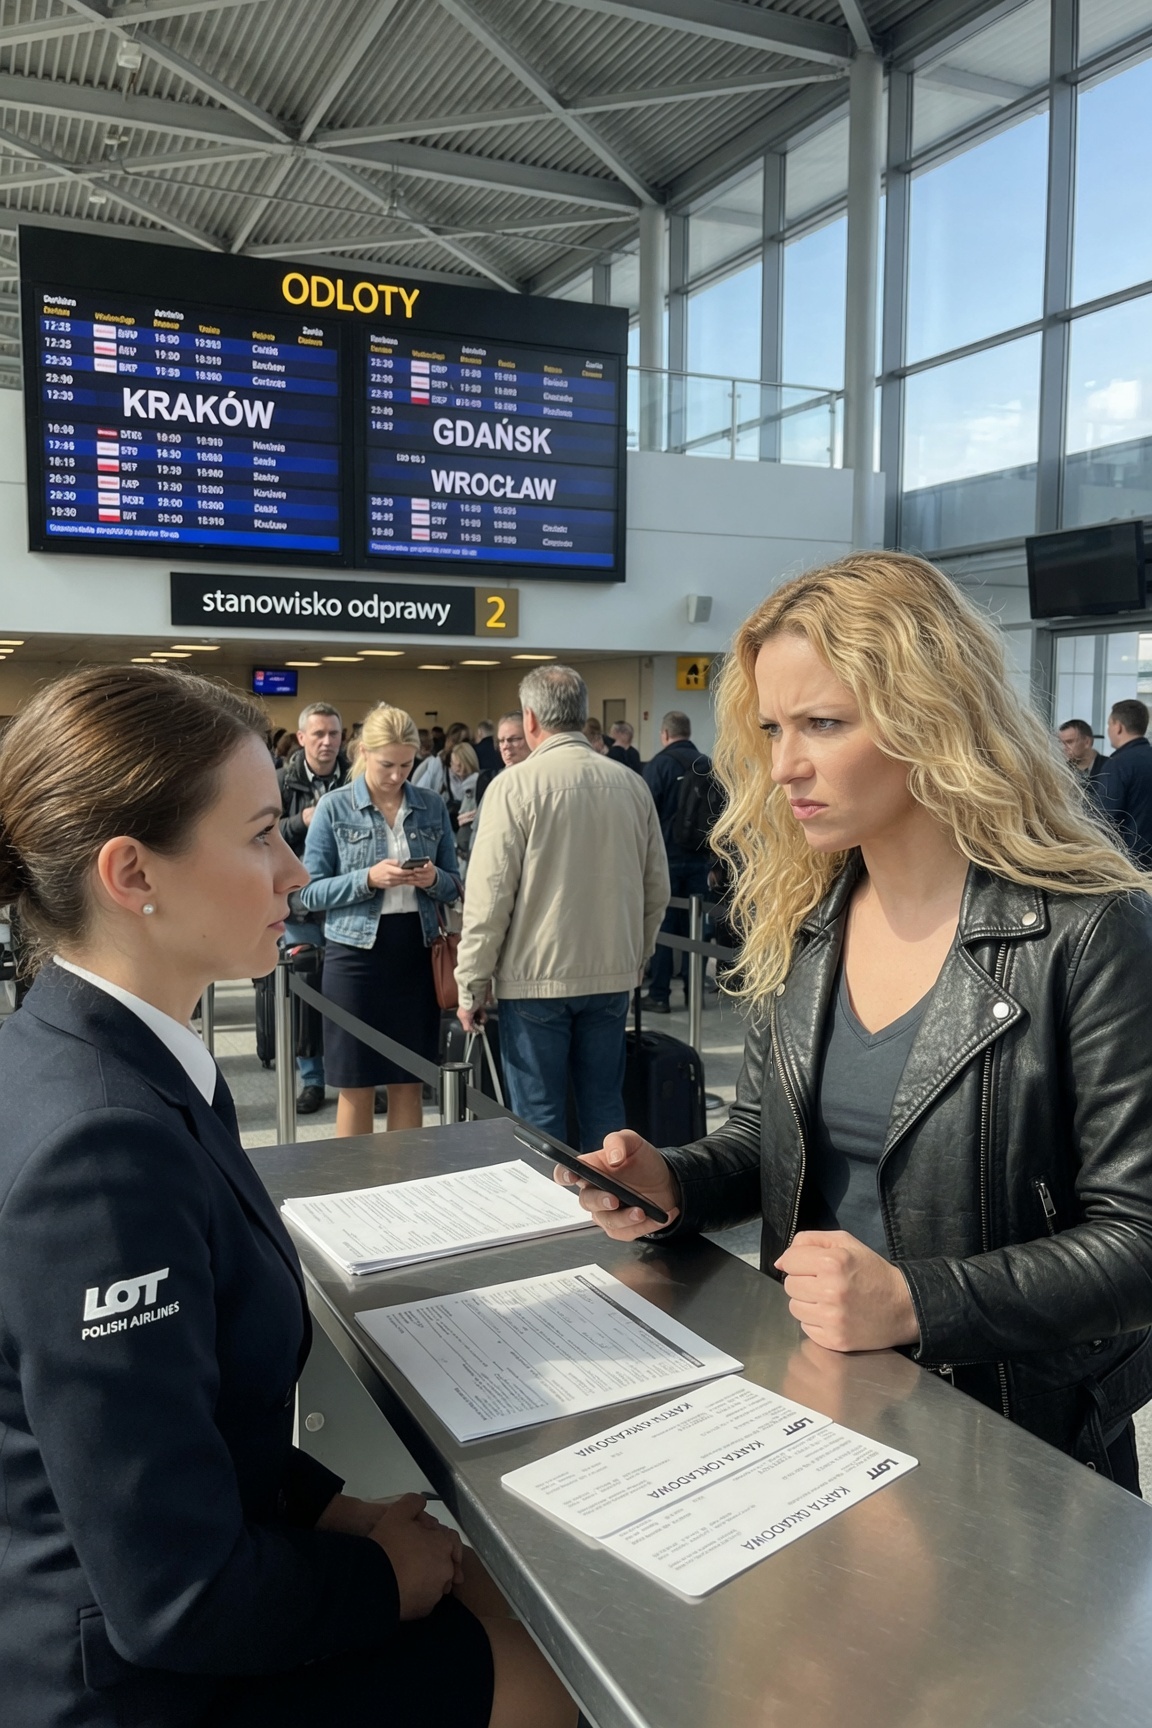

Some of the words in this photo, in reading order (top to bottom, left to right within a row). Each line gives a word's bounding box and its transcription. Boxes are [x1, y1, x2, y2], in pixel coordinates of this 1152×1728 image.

[282, 272, 420, 319] ODLOTY
[122, 387, 275, 430] KRAKÓW
[432, 417, 552, 455] GDAŃSK
[431, 468, 557, 502] WROCŁAW
[202, 588, 343, 618] stanowisko
[347, 593, 451, 628] odprawy
[485, 595, 507, 630] 2
[83, 1266, 170, 1322] LOT
[81, 1318, 128, 1341] POLISH
[129, 1300, 180, 1329] AIRLINES
[721, 1440, 765, 1463] KARTA
[808, 1485, 851, 1512] KARTA
